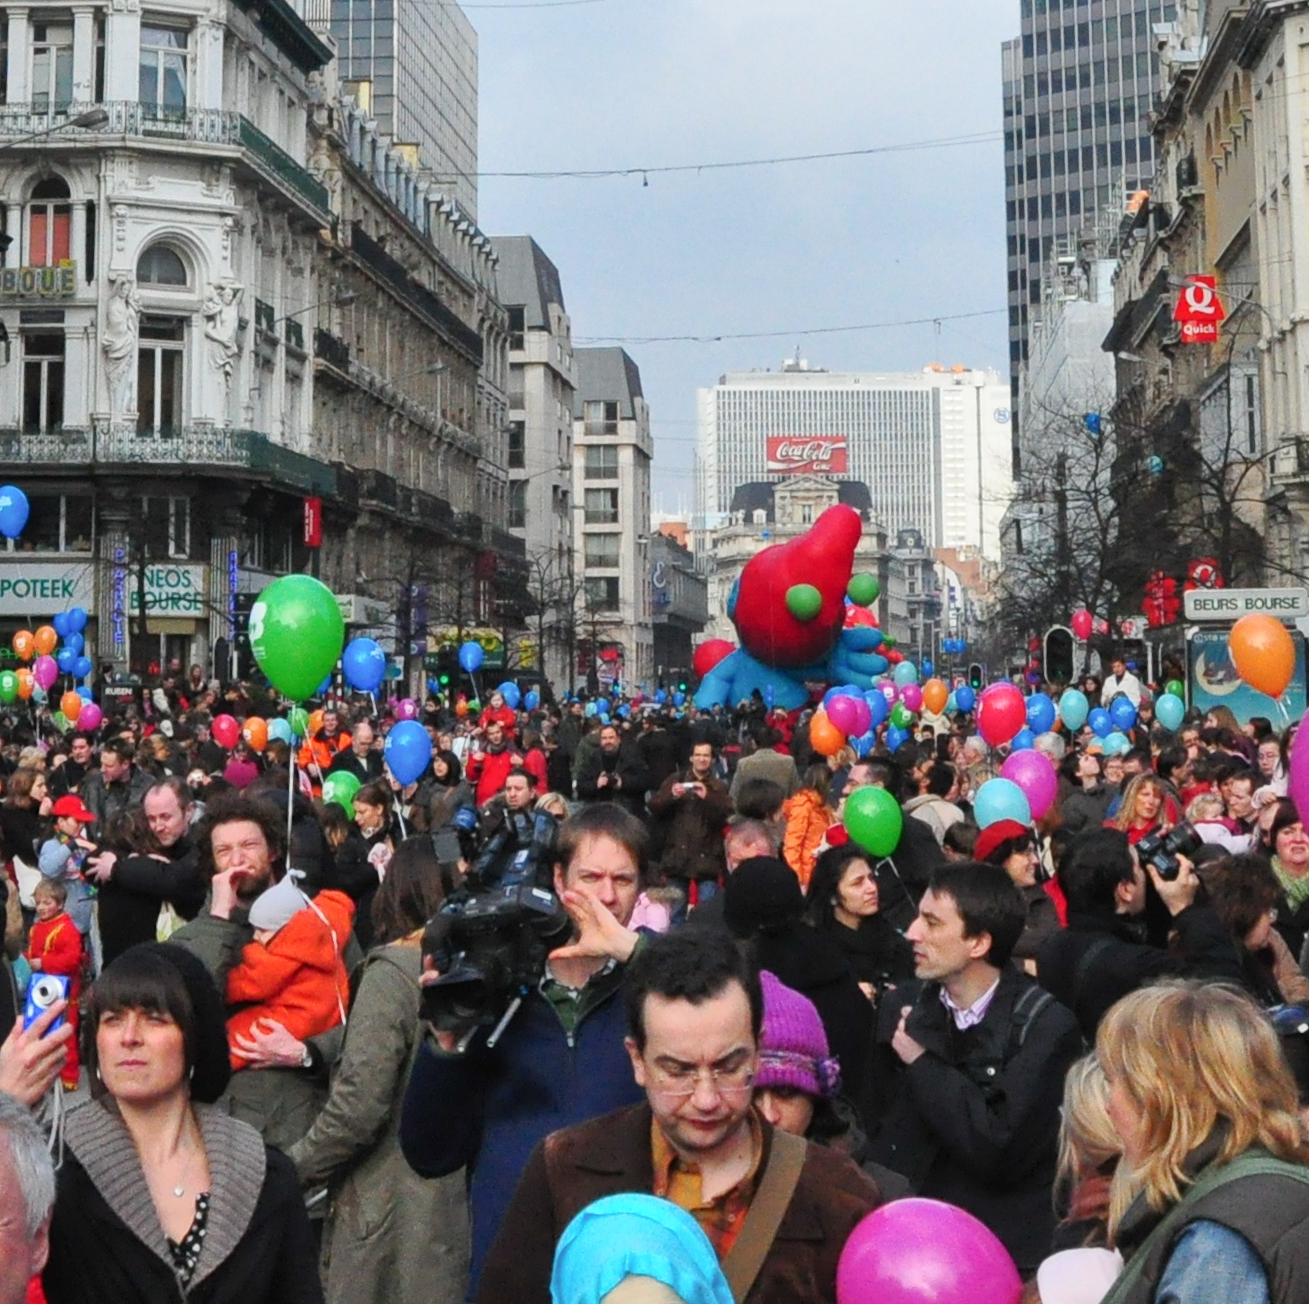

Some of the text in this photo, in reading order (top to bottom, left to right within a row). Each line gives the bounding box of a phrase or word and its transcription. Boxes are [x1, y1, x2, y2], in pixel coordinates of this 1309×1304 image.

[1183, 323, 1215, 336] Quick
[143, 569, 192, 589] NEOS
[129, 591, 203, 612] BOURSE
[1193, 596, 1301, 612] BEURS BOURSE
